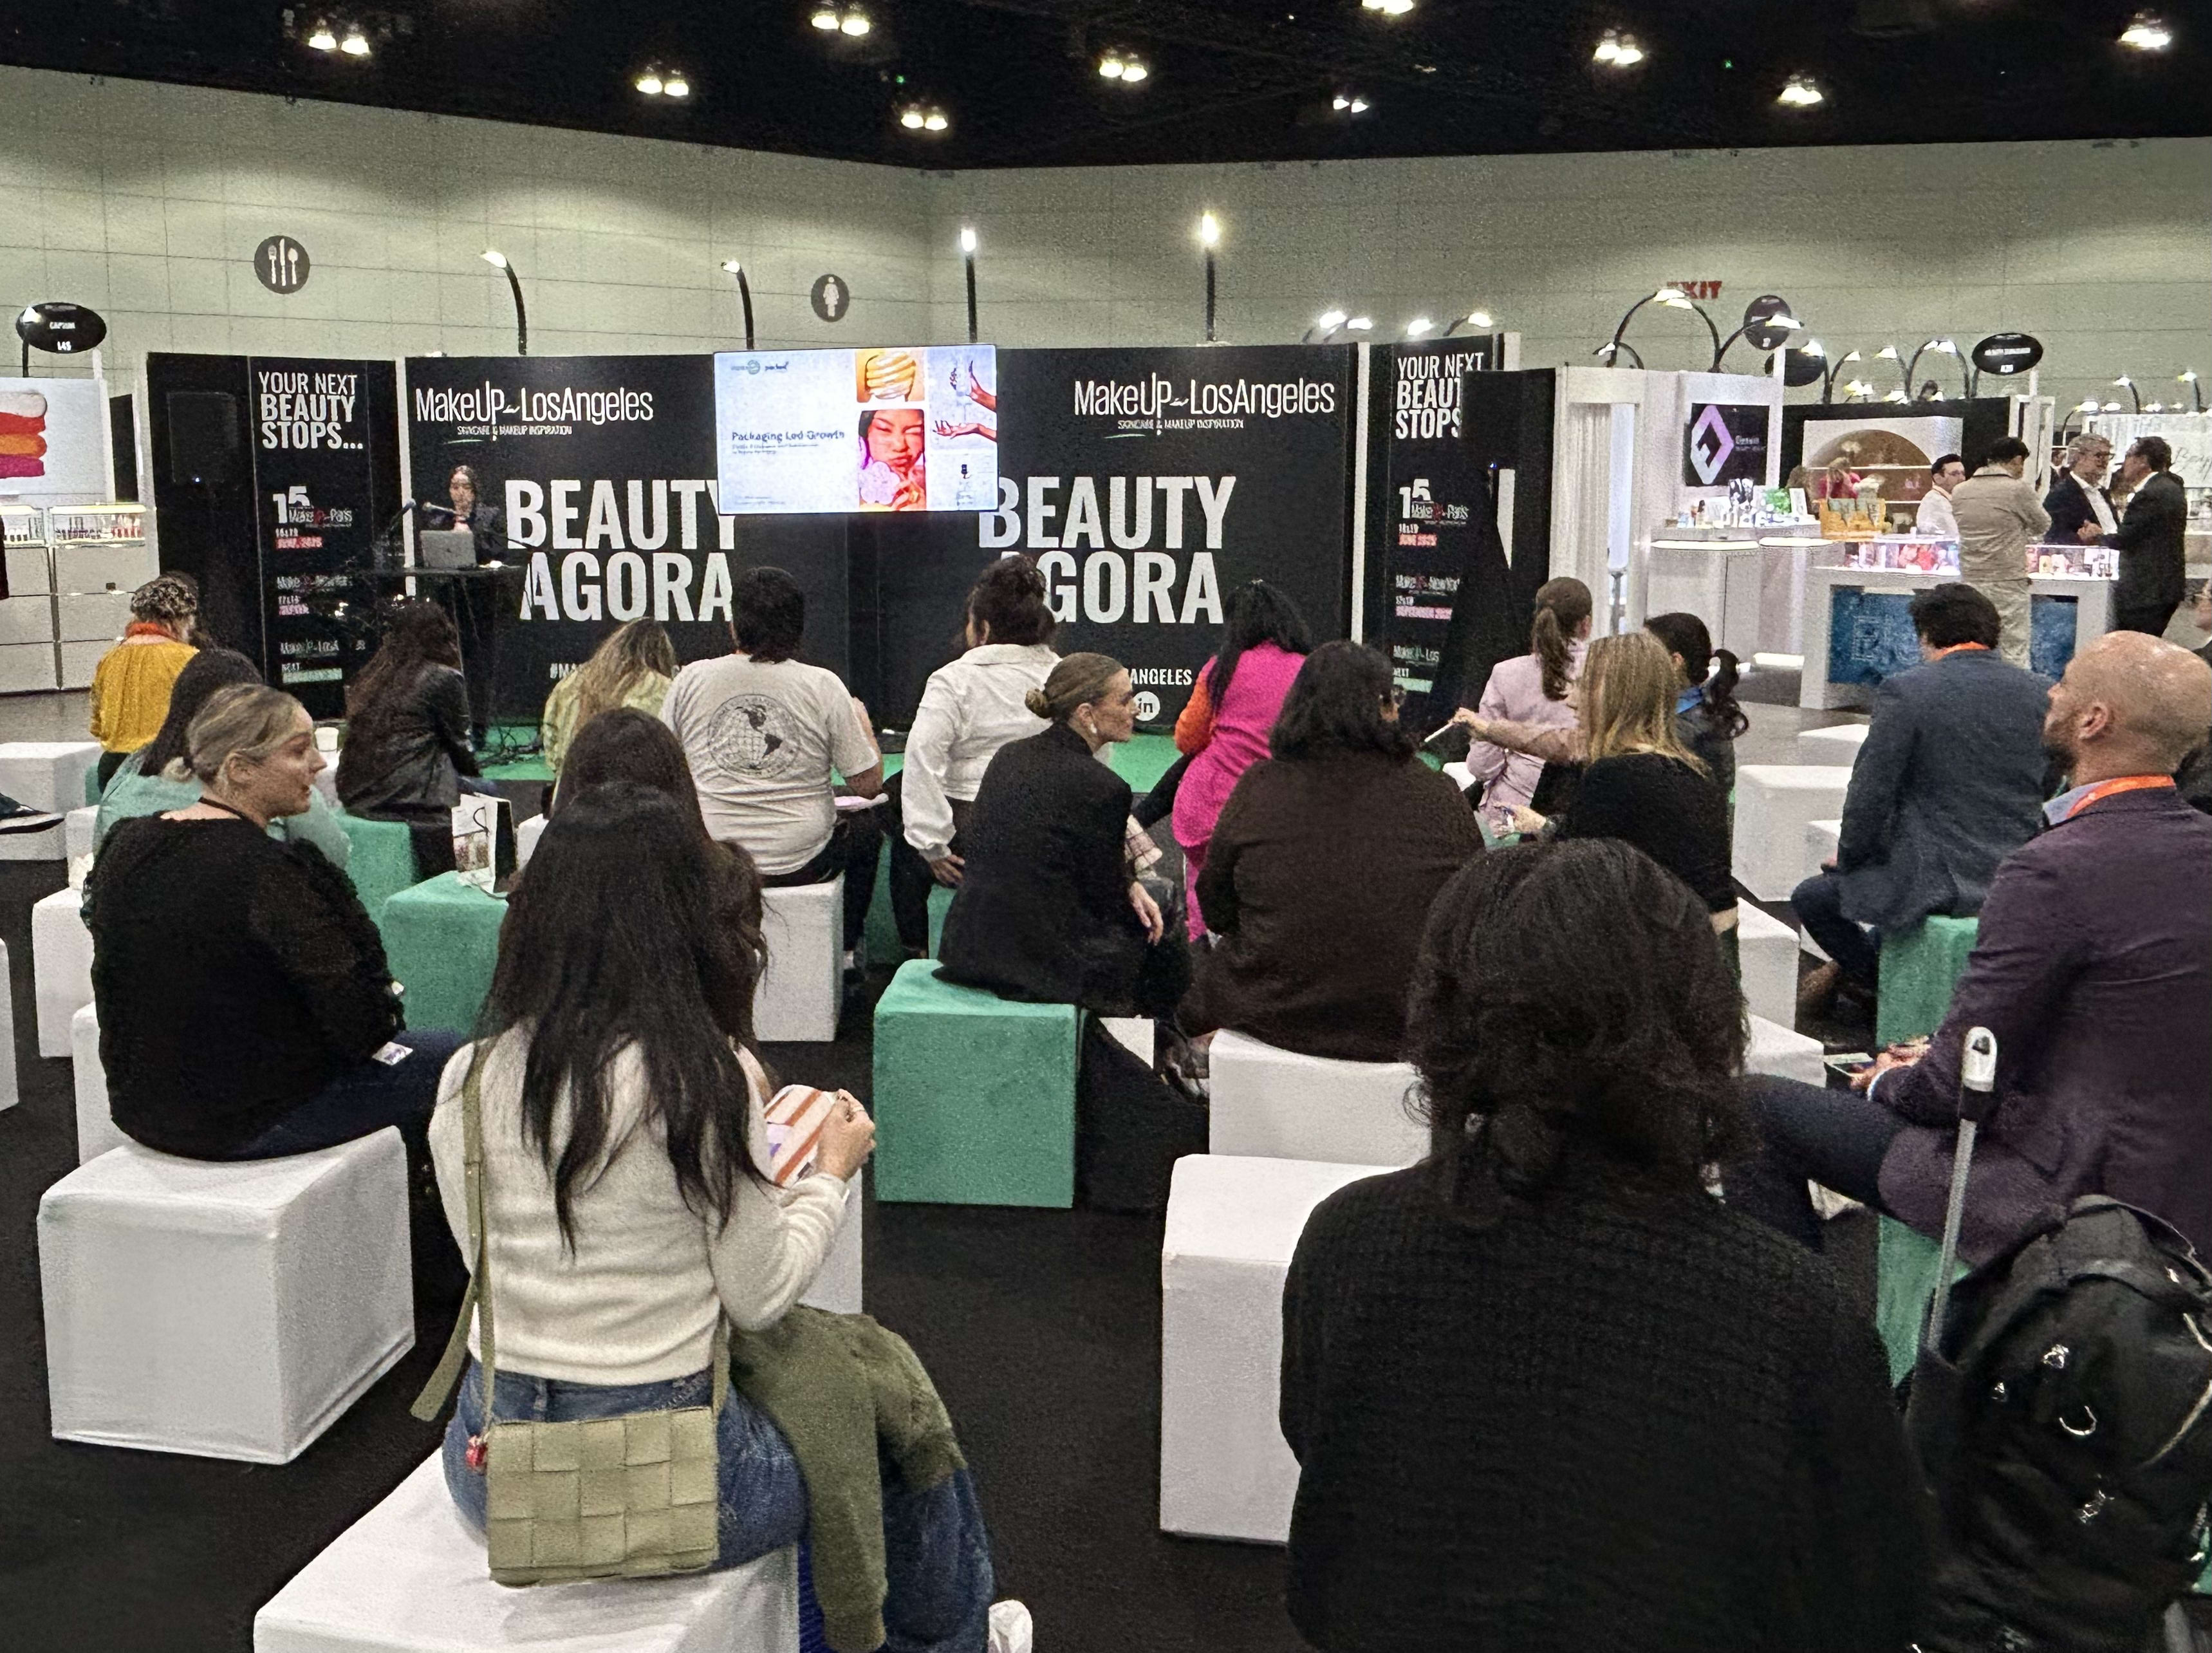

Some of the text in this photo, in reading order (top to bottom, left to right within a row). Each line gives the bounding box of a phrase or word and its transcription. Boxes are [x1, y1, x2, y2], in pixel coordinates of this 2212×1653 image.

[1667, 281, 1722, 299] XIT
[258, 371, 358, 395] YOUR NEXT
[1397, 352, 1484, 380] YOUR NEXT
[260, 393, 356, 422] BEAUTY
[521, 387, 654, 425] LosAngeles
[1190, 377, 1335, 418] LosAngeles
[1397, 377, 1461, 410] BEAUT
[272, 485, 311, 524] 15
[978, 476, 1236, 549] BEAUTY
[1399, 478, 1431, 519] 15
[519, 551, 734, 622] AGORA
[1000, 550, 1224, 624] GORA
